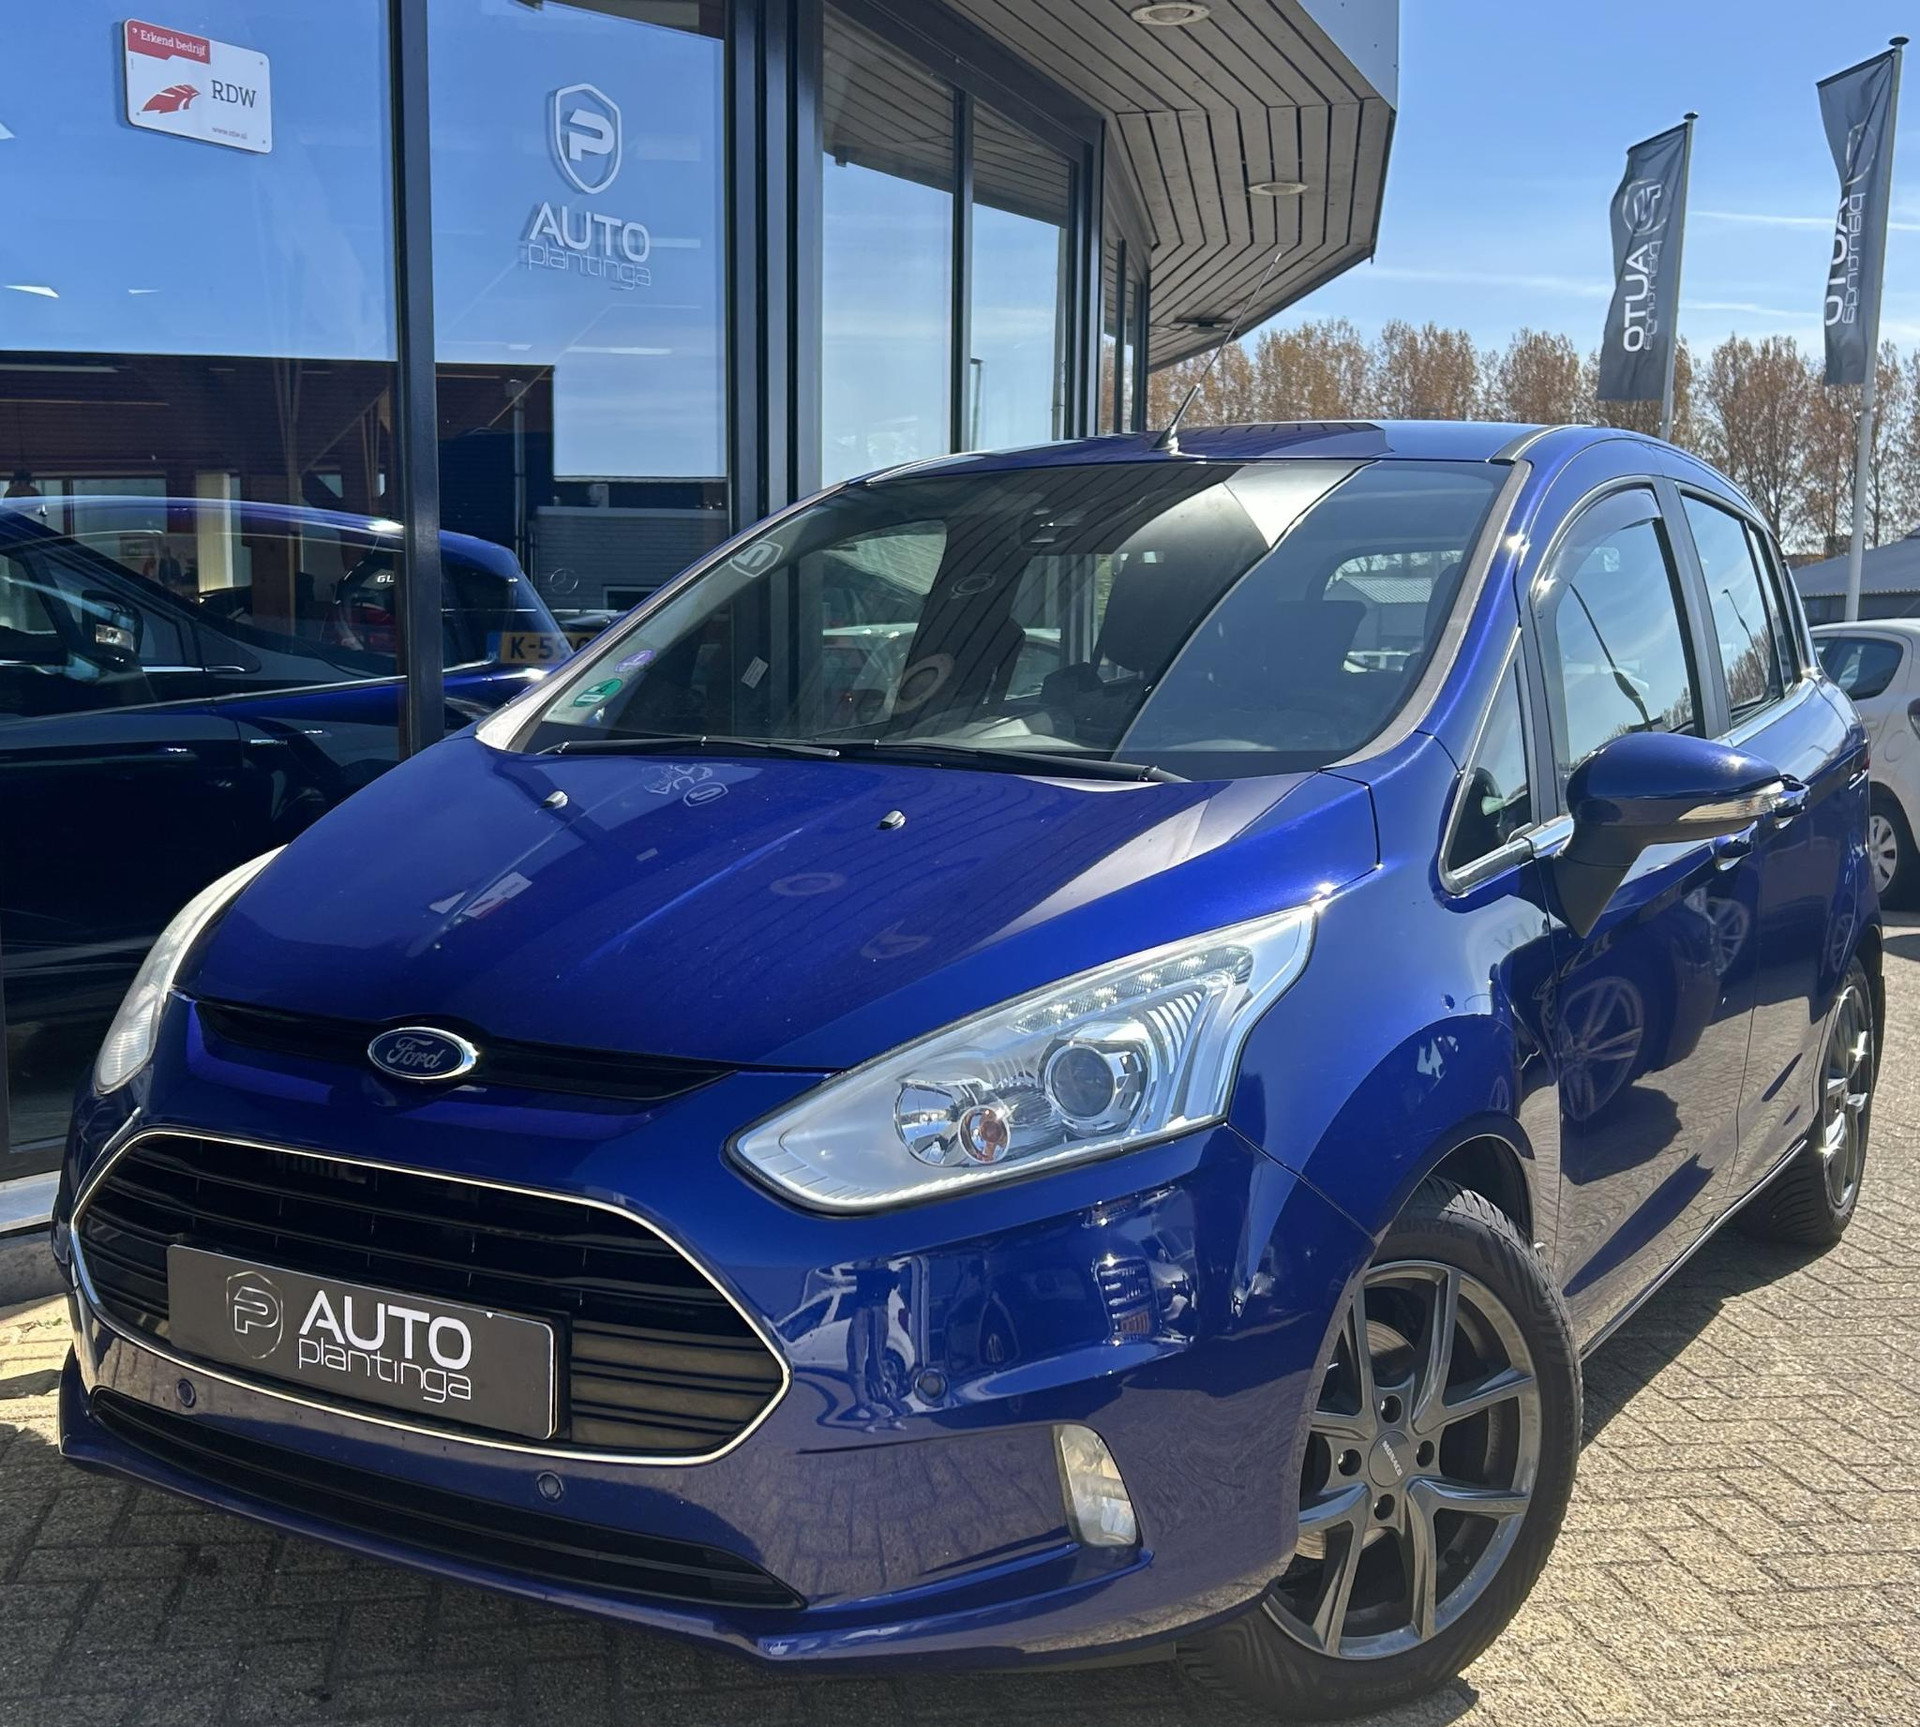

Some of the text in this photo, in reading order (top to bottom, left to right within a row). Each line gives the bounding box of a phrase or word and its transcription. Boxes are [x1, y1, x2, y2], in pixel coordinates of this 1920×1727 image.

[141, 29, 207, 57] Erkend bedrijf
[211, 79, 257, 108] RDW
[529, 201, 650, 263] AUTO
[528, 243, 651, 290] plantinga
[387, 1036, 446, 1068] Ford
[299, 1290, 473, 1370] AUTO
[298, 1337, 473, 1404] plantinga
